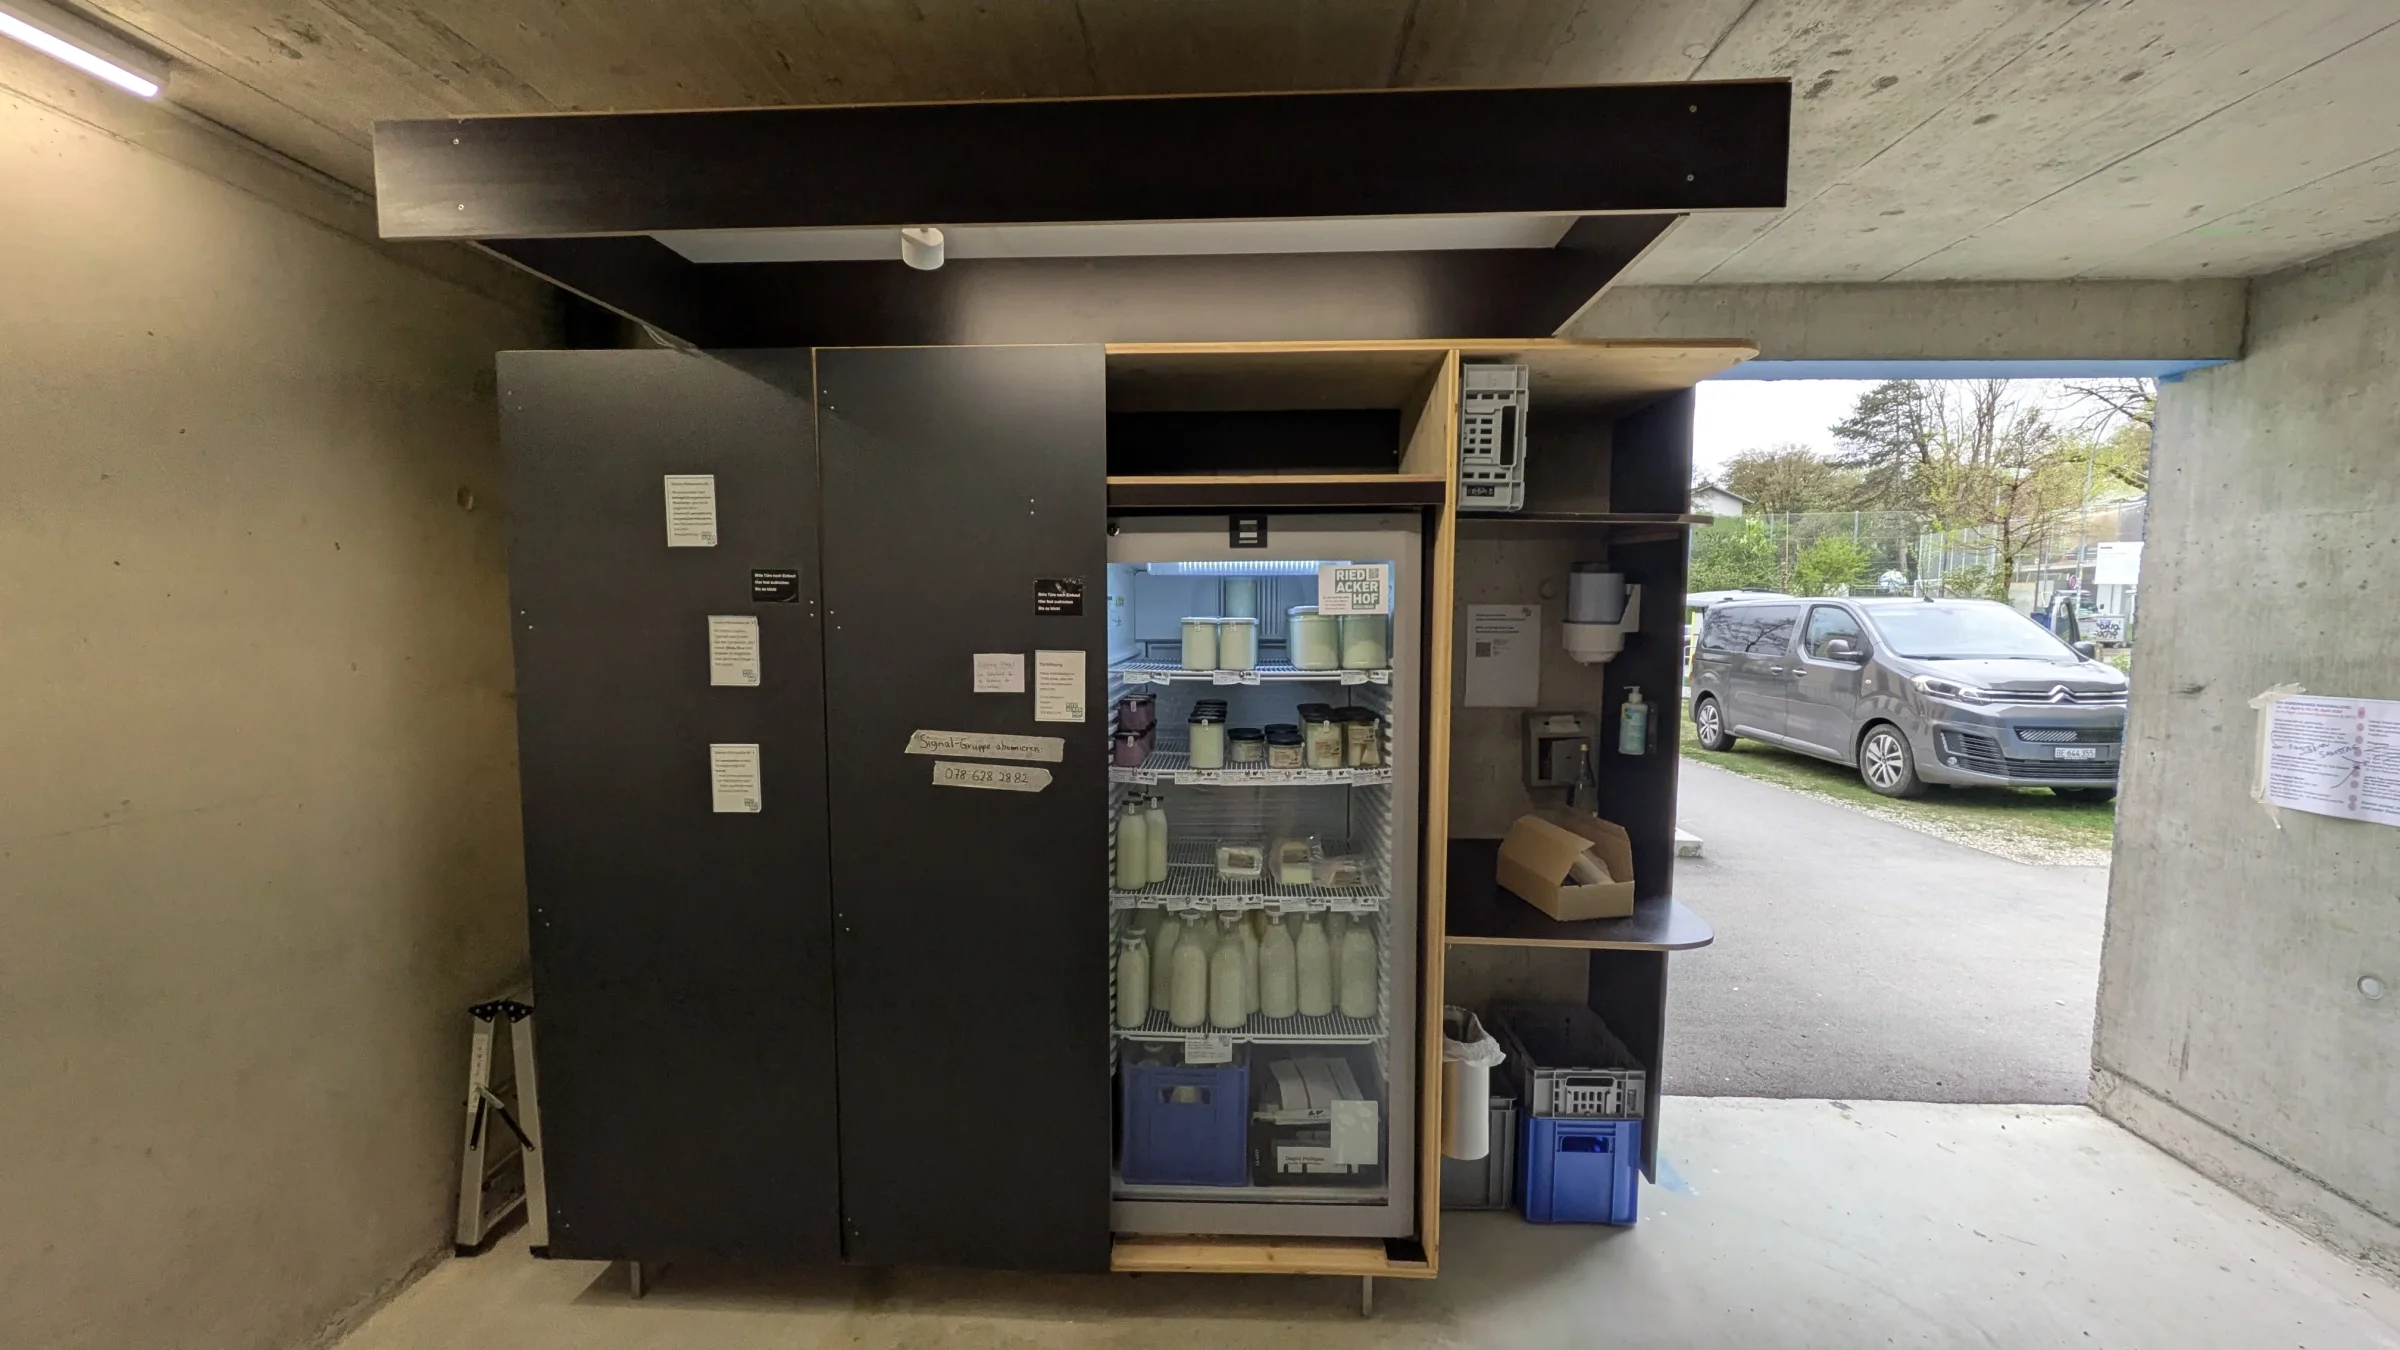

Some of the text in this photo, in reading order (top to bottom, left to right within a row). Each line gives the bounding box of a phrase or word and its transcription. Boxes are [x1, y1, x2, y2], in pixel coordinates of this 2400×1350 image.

[1336, 569, 1365, 581] RIED
[1336, 581, 1379, 592] ACKER
[1353, 593, 1379, 604] HOF
[919, 733, 991, 752] Signal-Gruppe
[2056, 749, 2095, 757] BE 644 355
[944, 767, 967, 780] 078
[972, 769, 993, 782] 628
